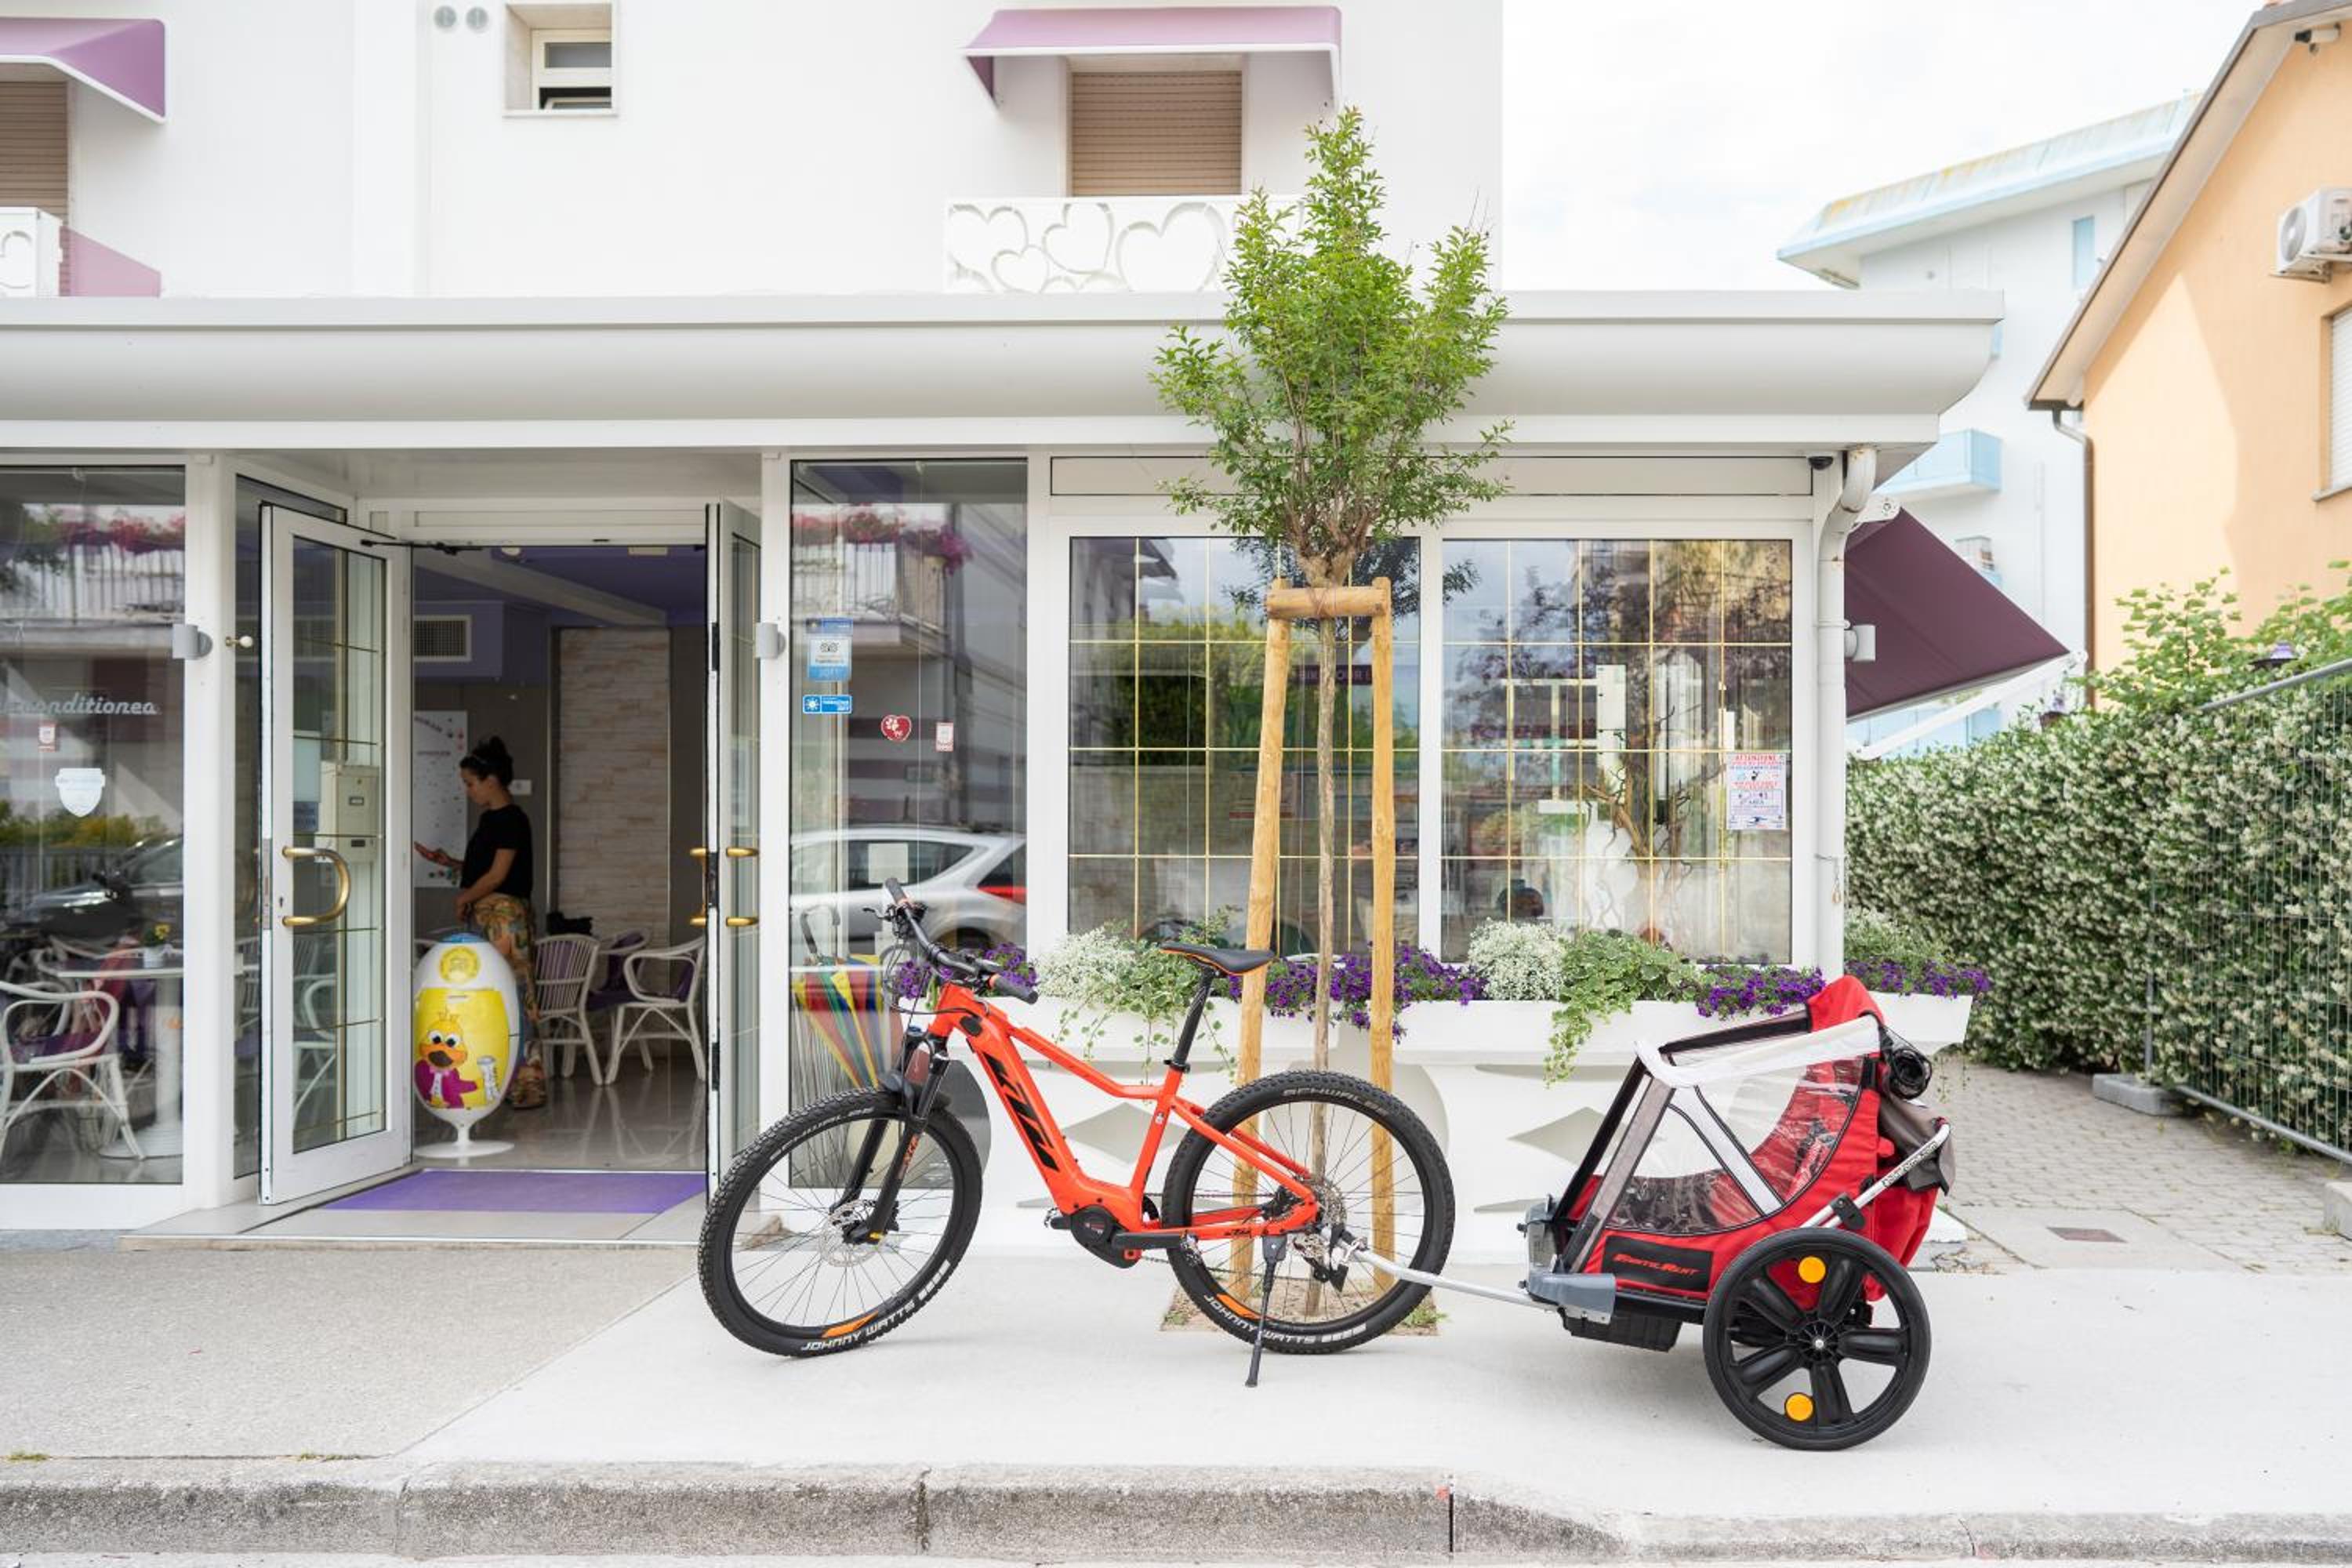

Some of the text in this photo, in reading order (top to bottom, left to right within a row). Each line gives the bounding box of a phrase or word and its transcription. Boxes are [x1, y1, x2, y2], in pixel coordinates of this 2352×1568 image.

[982, 1051, 1061, 1172] KTM
[1203, 1294, 1258, 1332] JOHNNY
[800, 1330, 862, 1352] JOHNNY
